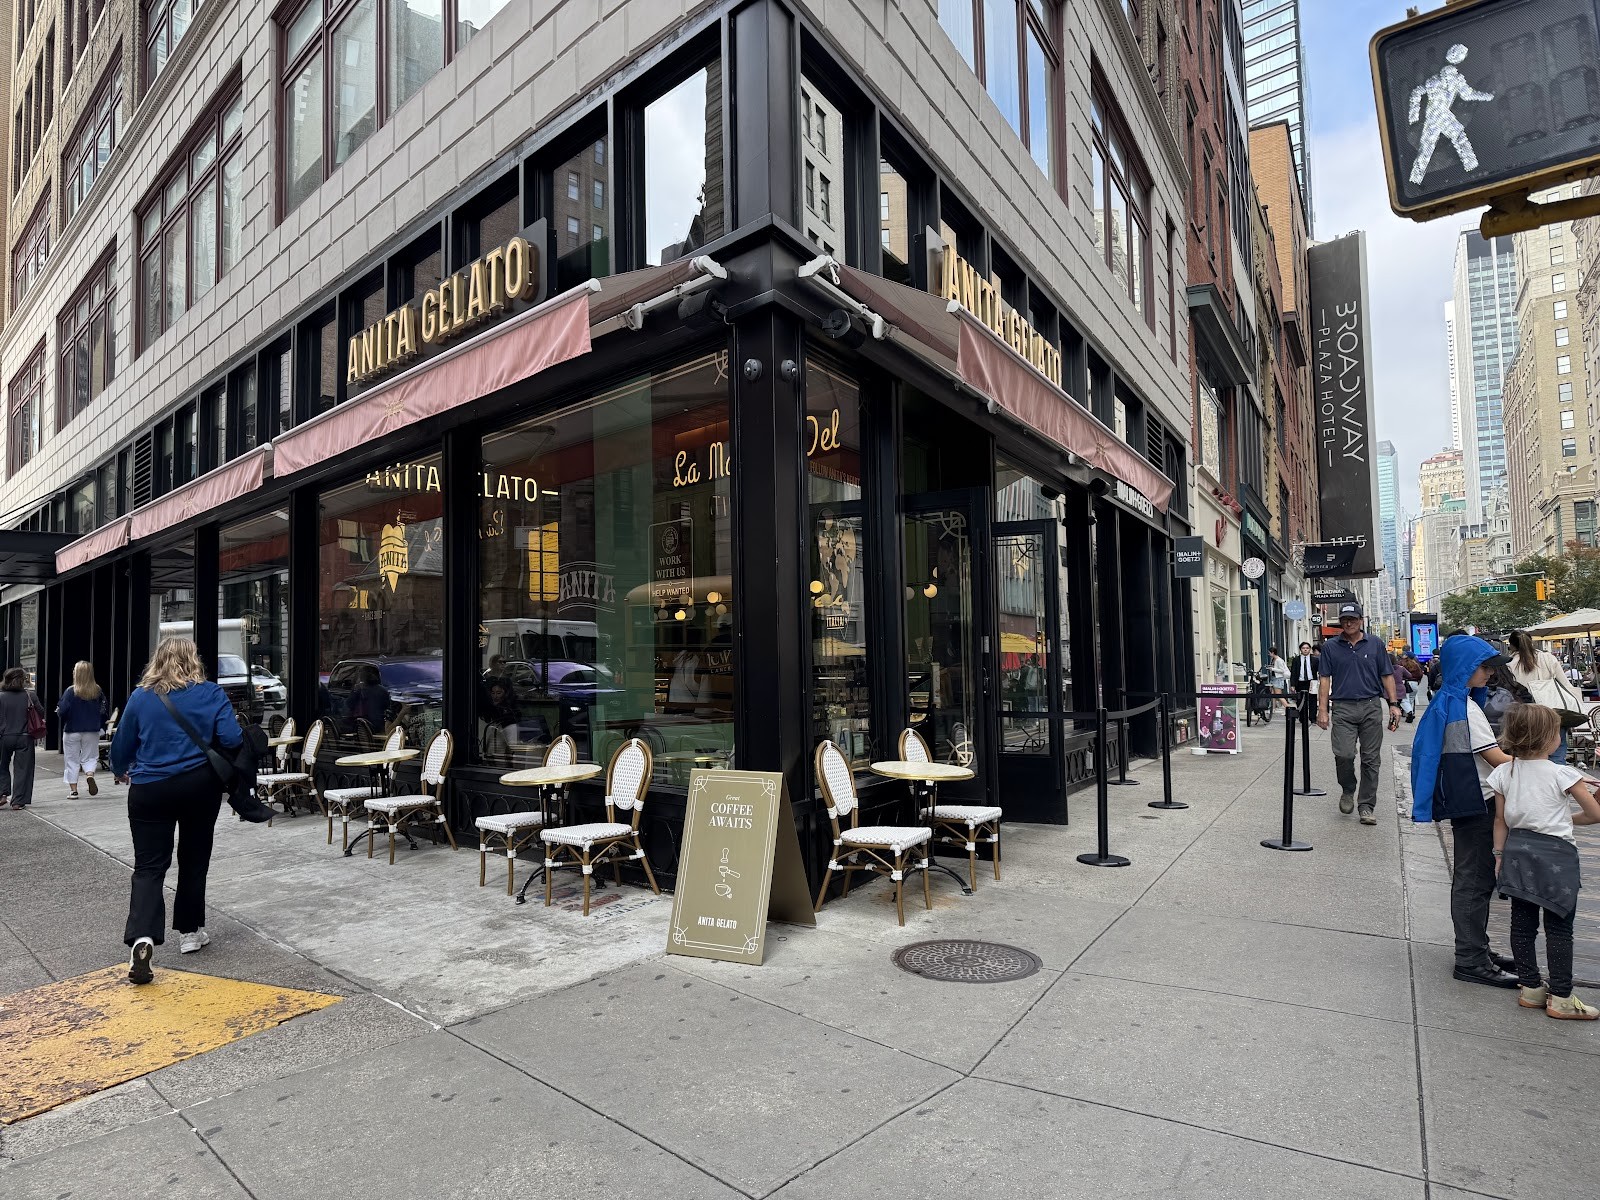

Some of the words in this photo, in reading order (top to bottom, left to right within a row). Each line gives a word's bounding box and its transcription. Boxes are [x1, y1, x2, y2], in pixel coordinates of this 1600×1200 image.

[942, 244, 1004, 341] ANITA
[347, 303, 417, 385] ANITA
[421, 237, 530, 343] GELATO
[1318, 327, 1333, 384] PLAZA
[1321, 390, 1336, 449] HOTEL
[673, 450, 700, 487] La
[478, 472, 538, 502] LATO
[380, 551, 407, 569] ANITA
[659, 555, 682, 566] WORK
[656, 567, 675, 578] WITH
[677, 567, 686, 576] US
[558, 570, 616, 603] ANITA
[652, 589, 666, 597] HELP
[667, 587, 690, 596] WANTED
[710, 802, 754, 816] COFFEE
[708, 816, 753, 830] AWAITS
[697, 915, 715, 927] ANITA
[716, 917, 738, 929] GELATO
